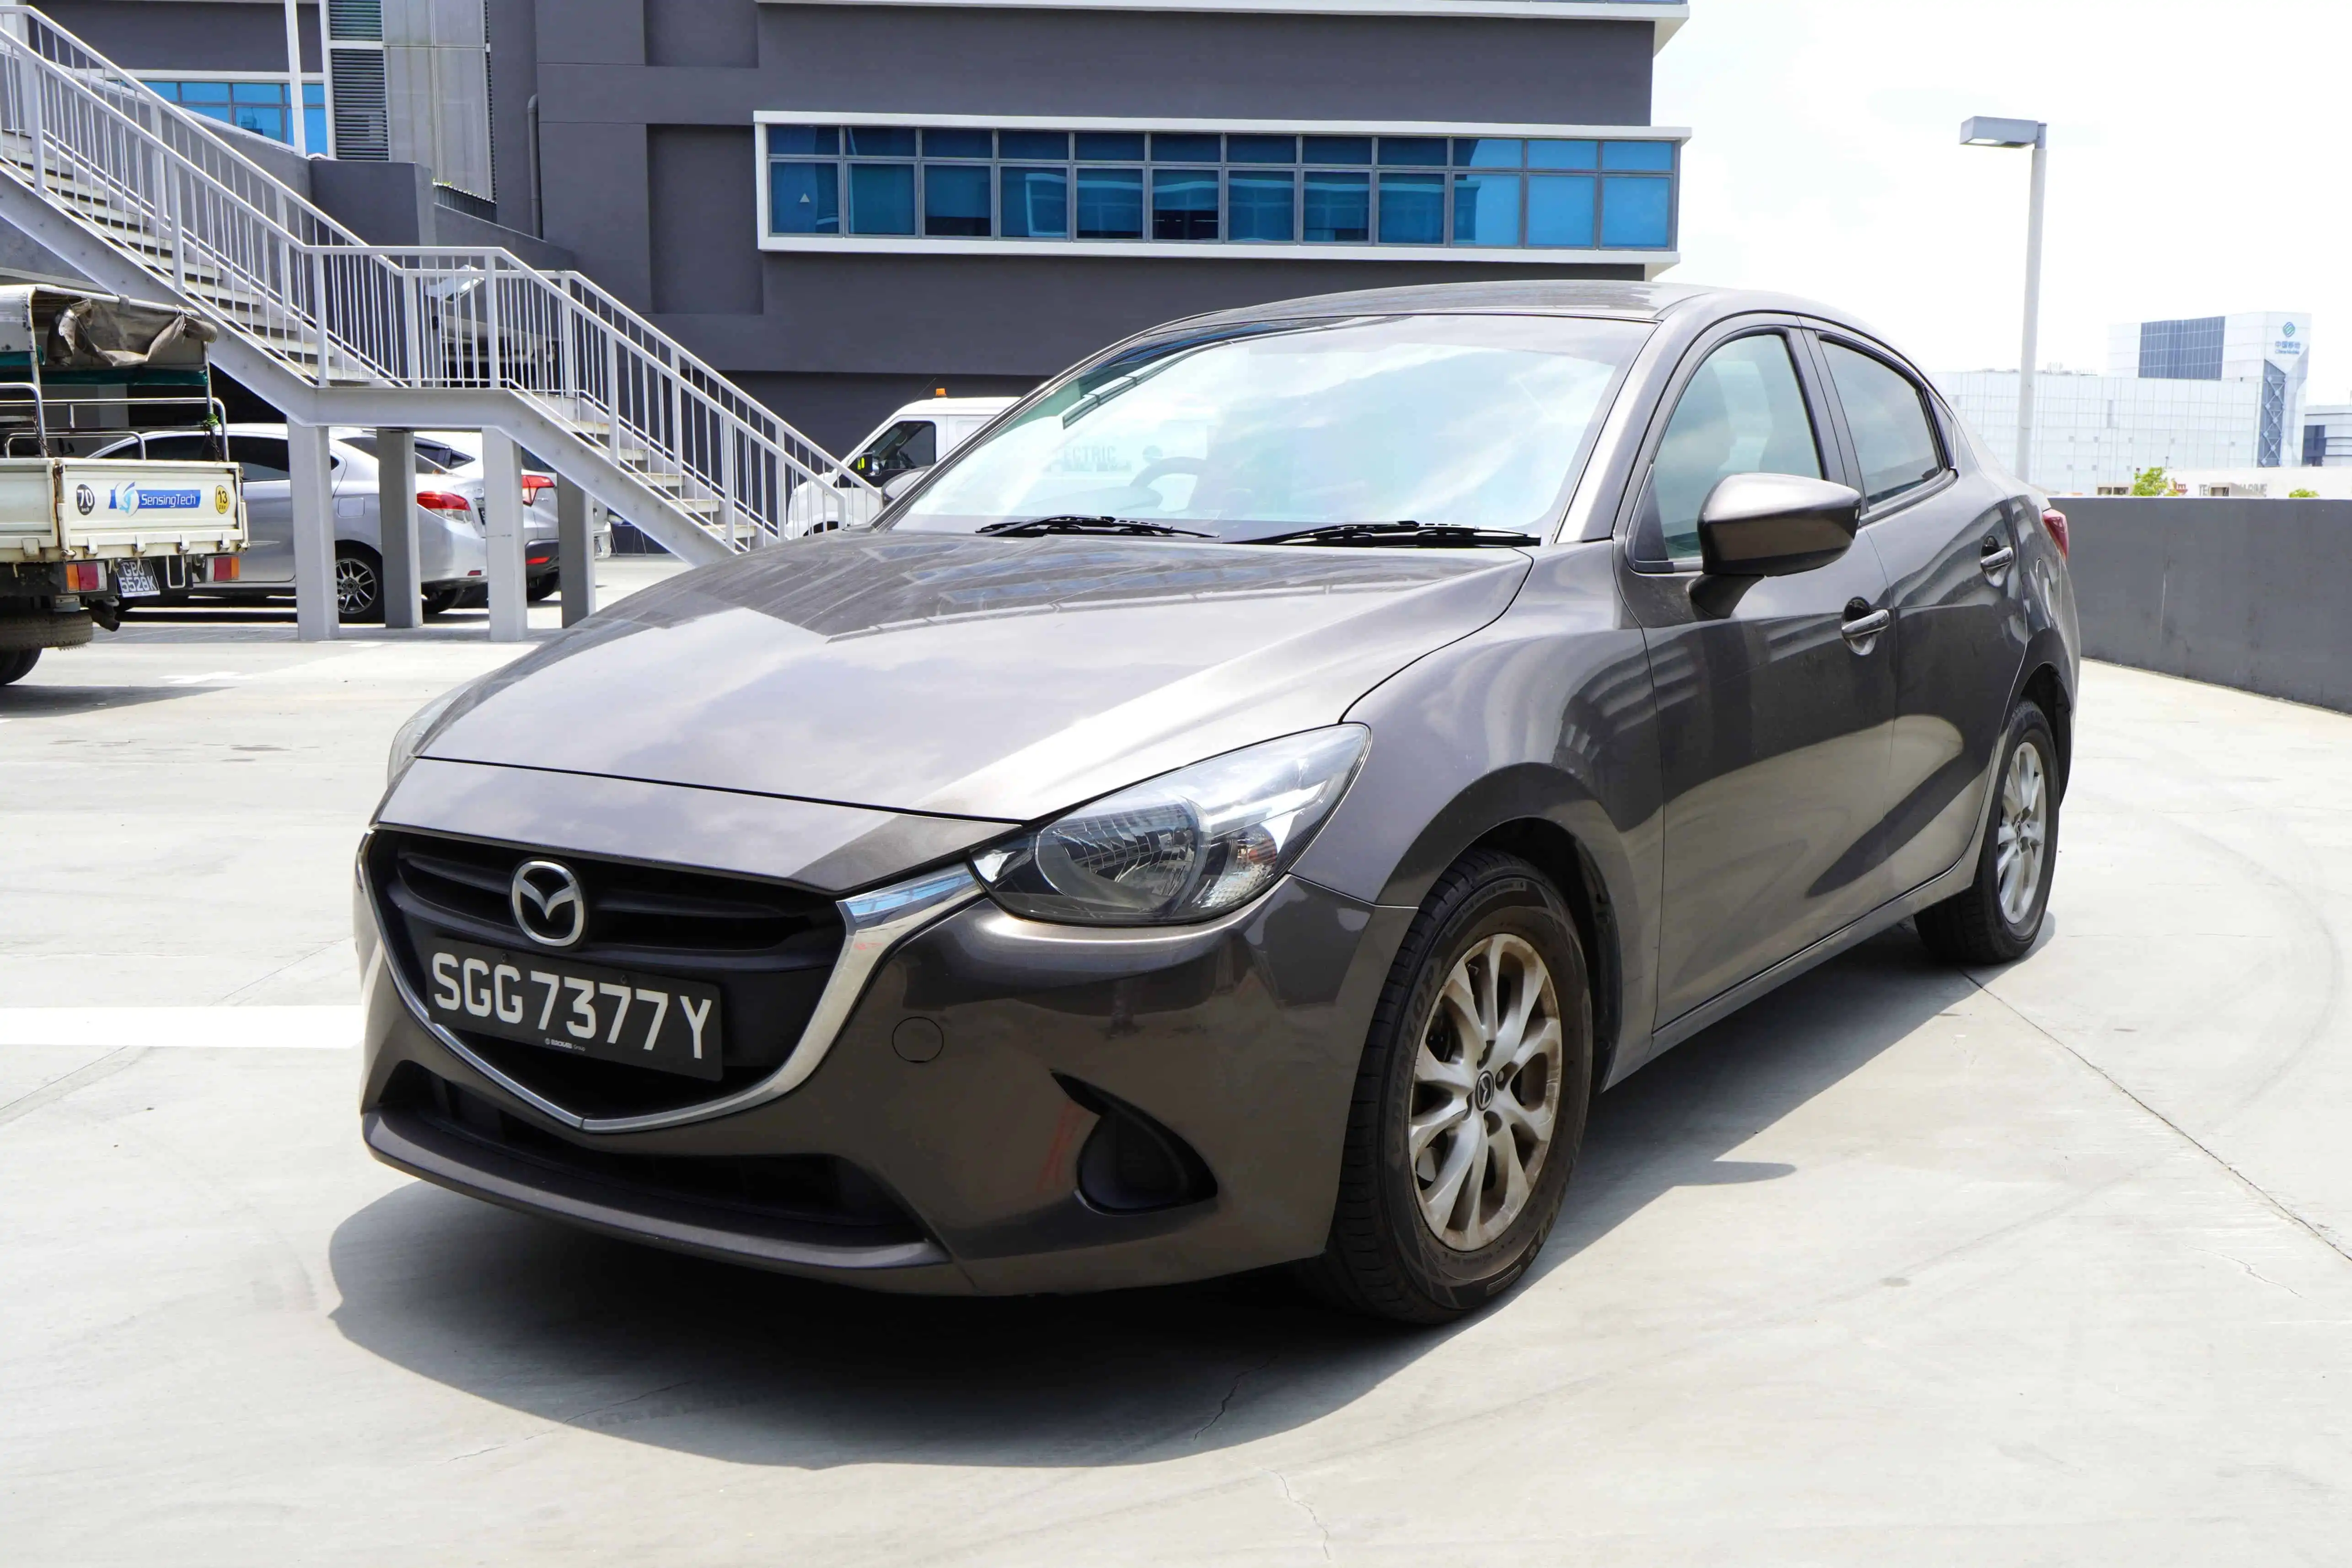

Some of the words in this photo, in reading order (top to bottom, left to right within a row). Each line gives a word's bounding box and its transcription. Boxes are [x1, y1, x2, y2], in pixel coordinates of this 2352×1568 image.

[77, 489, 93, 506] 70
[141, 494, 195, 508] SensingTech
[218, 490, 227, 504] 13
